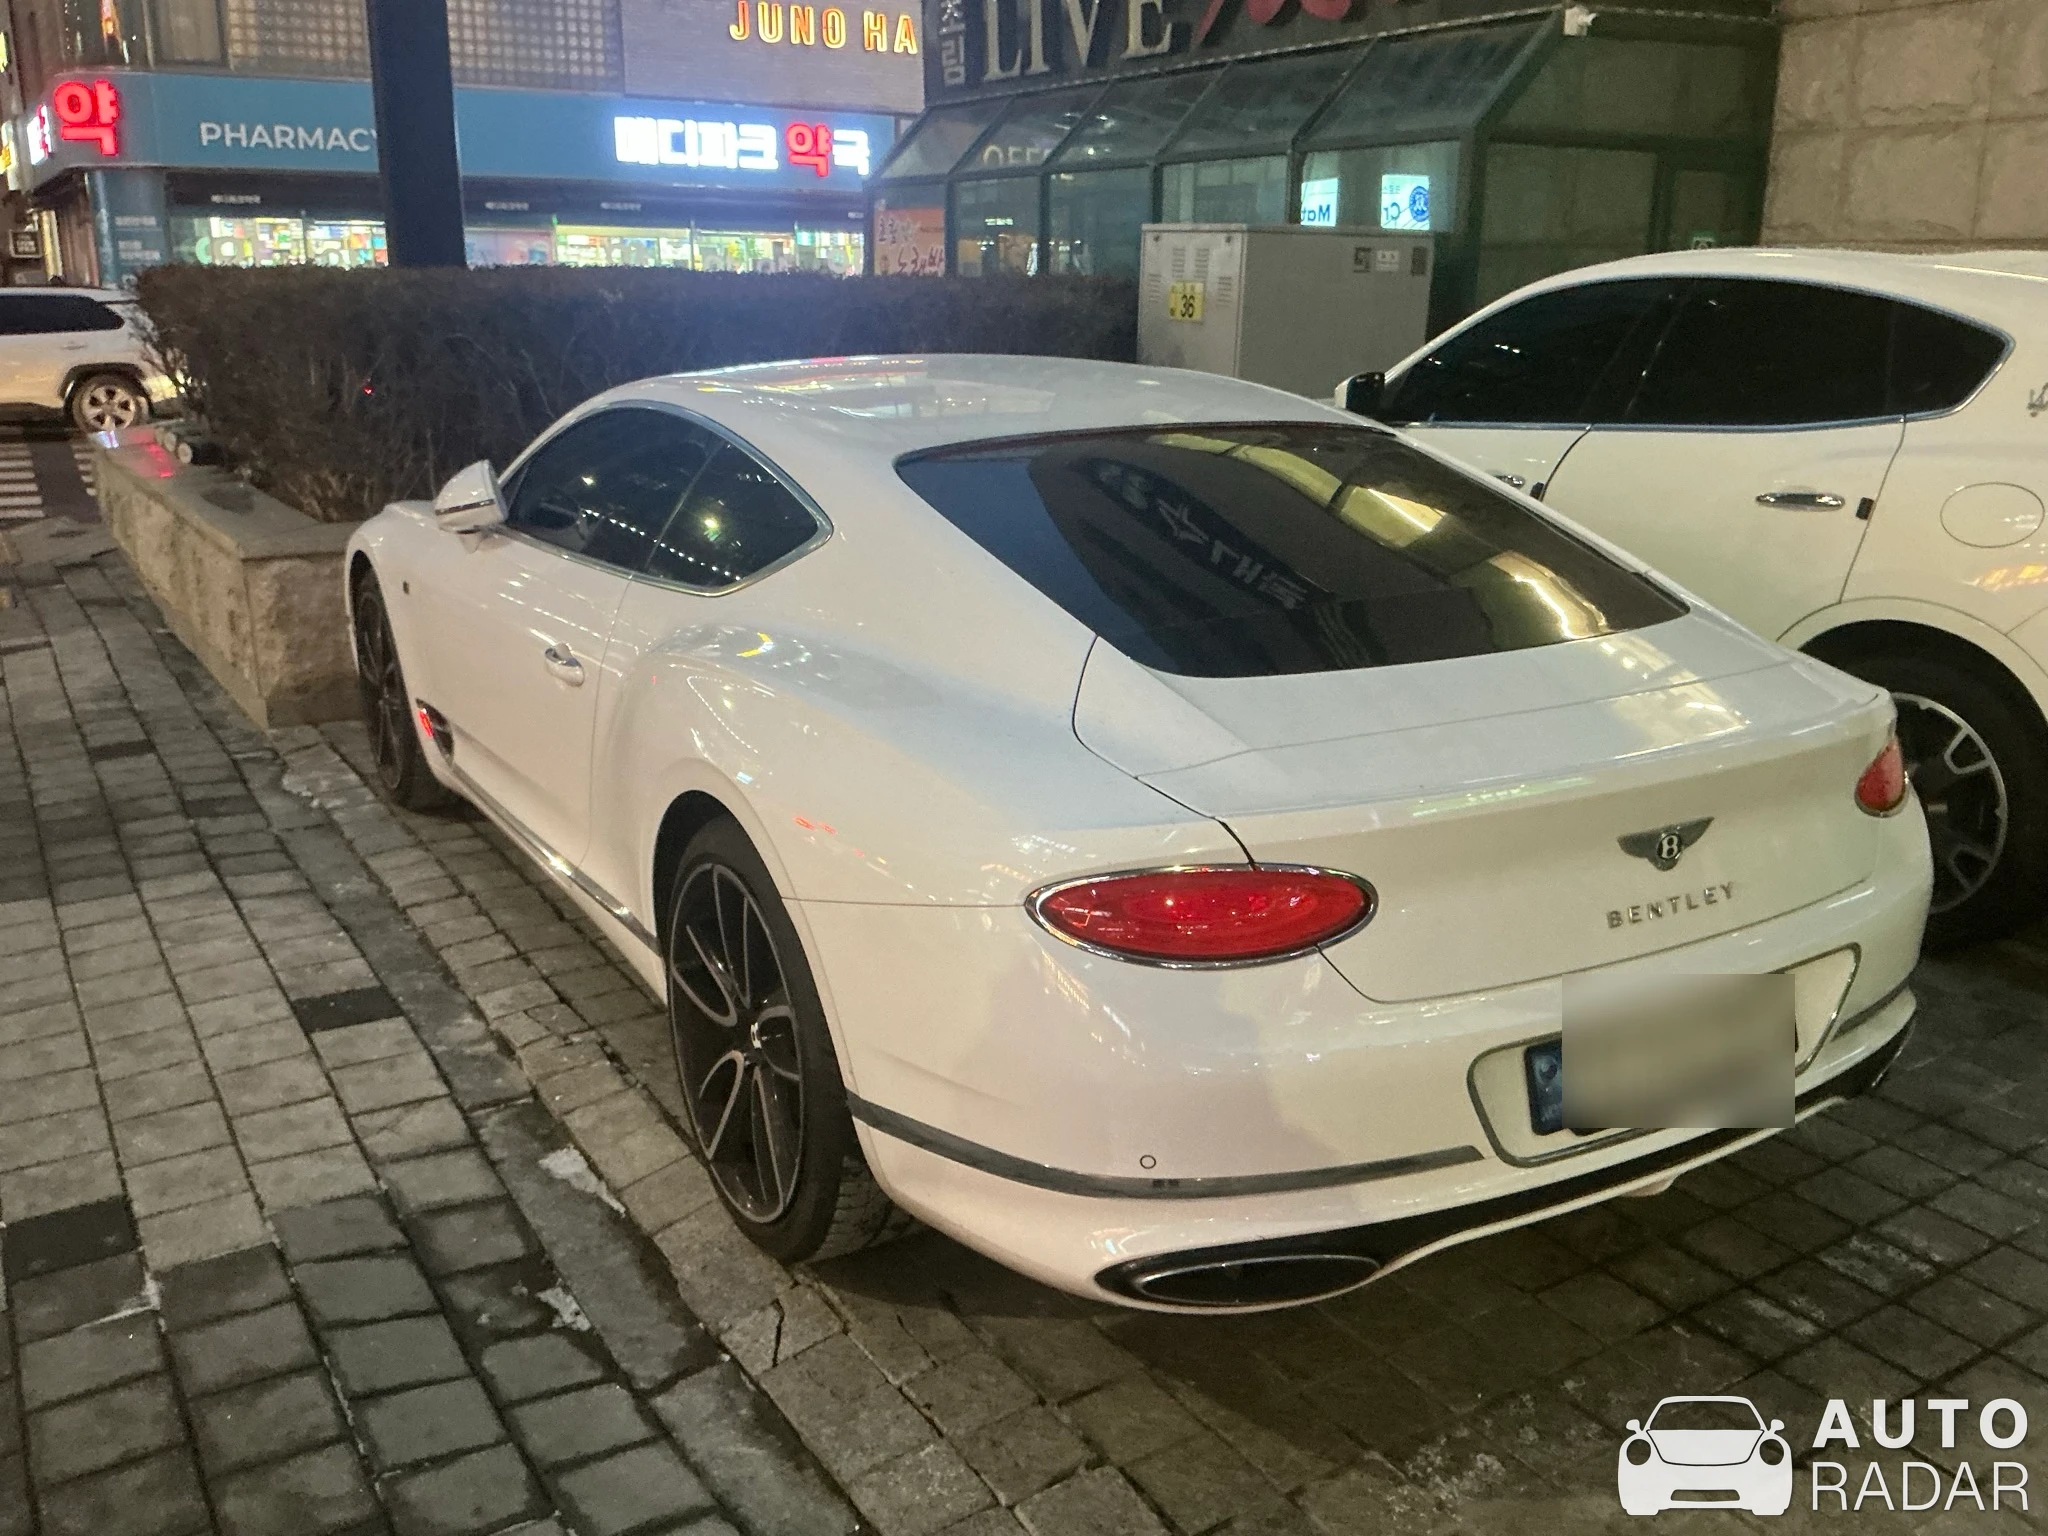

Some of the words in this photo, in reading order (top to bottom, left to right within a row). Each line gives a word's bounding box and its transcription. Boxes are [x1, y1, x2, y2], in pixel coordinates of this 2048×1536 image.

[729, 0, 847, 49] JUNO
[863, 10, 918, 55] HA
[54, 80, 119, 156] 약
[200, 121, 377, 152] PHARMAC
[1606, 881, 1734, 929] BENTLEY
